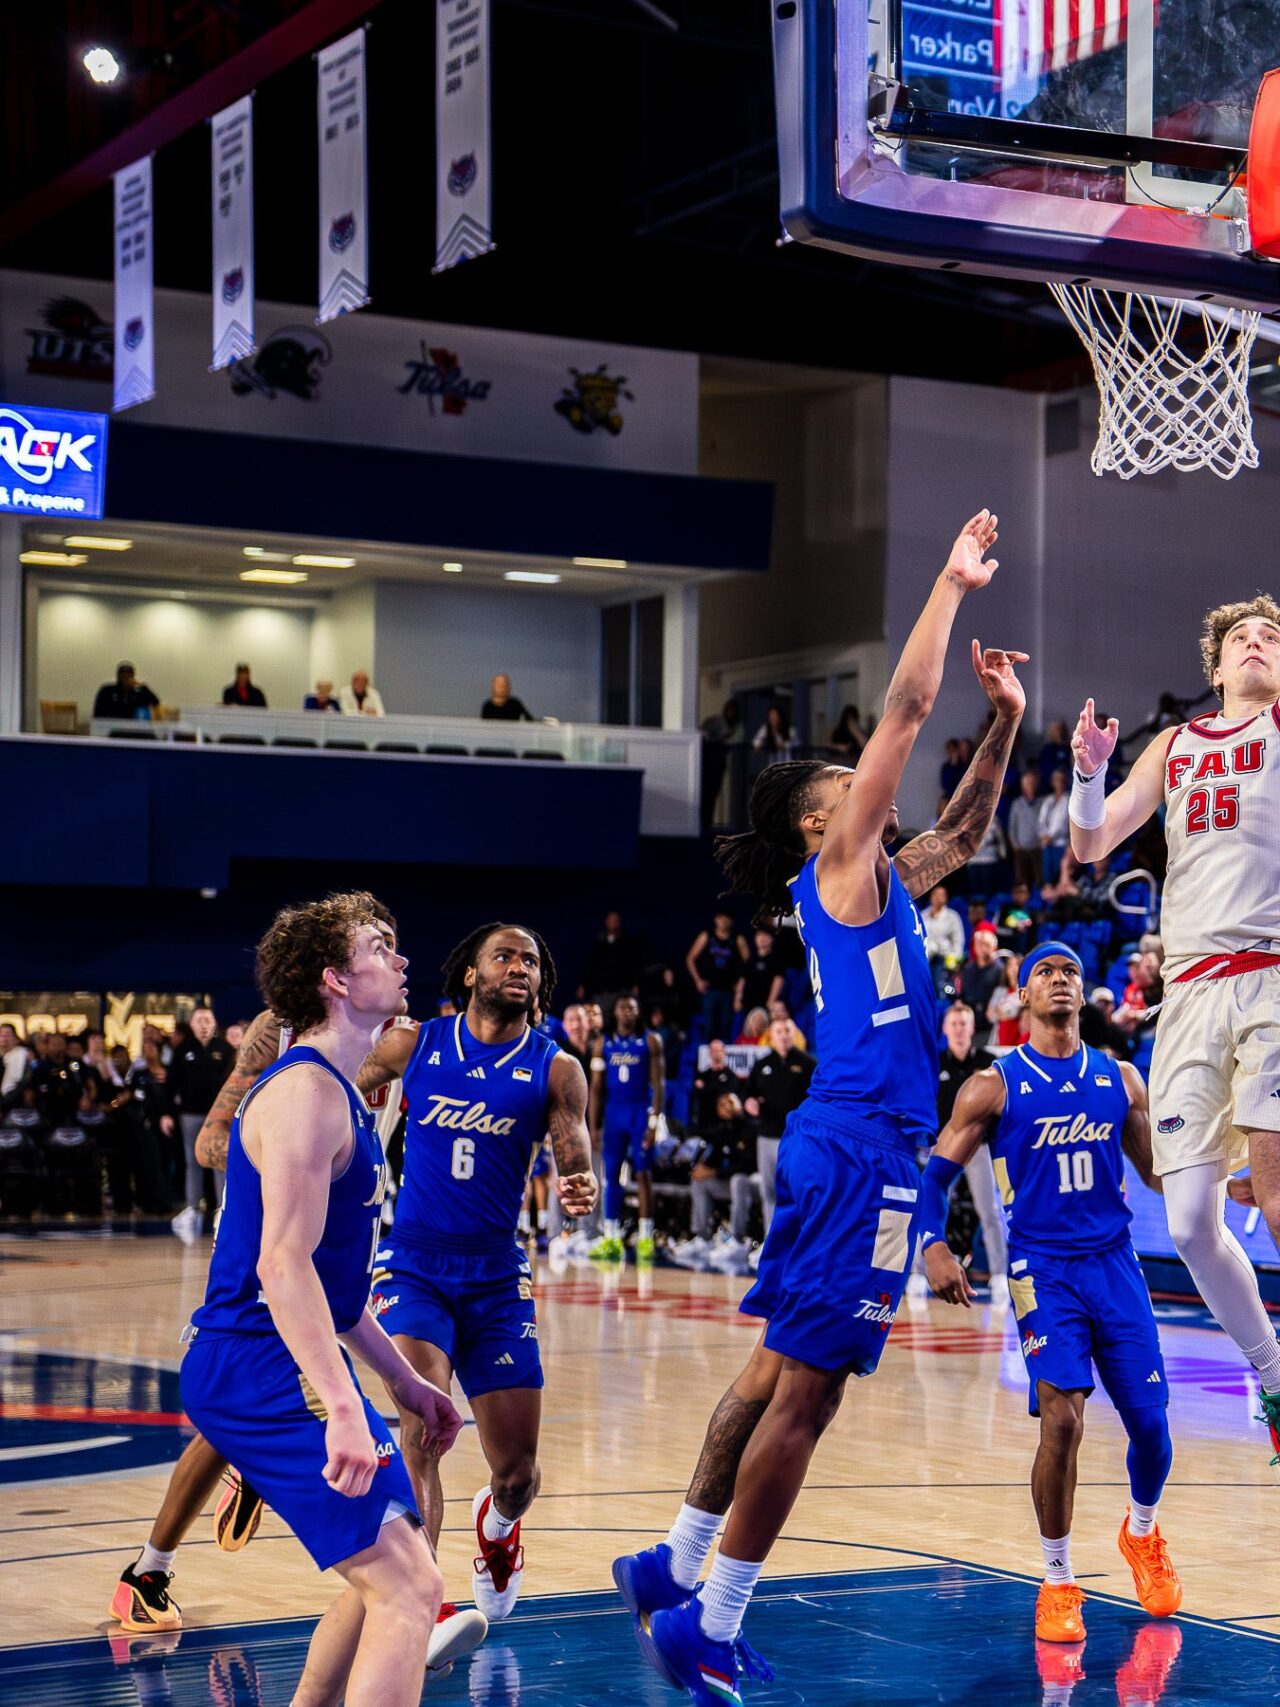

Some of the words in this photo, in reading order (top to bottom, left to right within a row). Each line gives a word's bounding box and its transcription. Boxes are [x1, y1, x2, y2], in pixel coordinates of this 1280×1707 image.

[1166, 738, 1266, 794] FAU
[1186, 783, 1240, 838] 25
[418, 1094, 517, 1136] Tulsa
[1031, 1112, 1114, 1150] Tulsa
[451, 1137, 476, 1180] 6
[1056, 1150, 1095, 1194] 10
